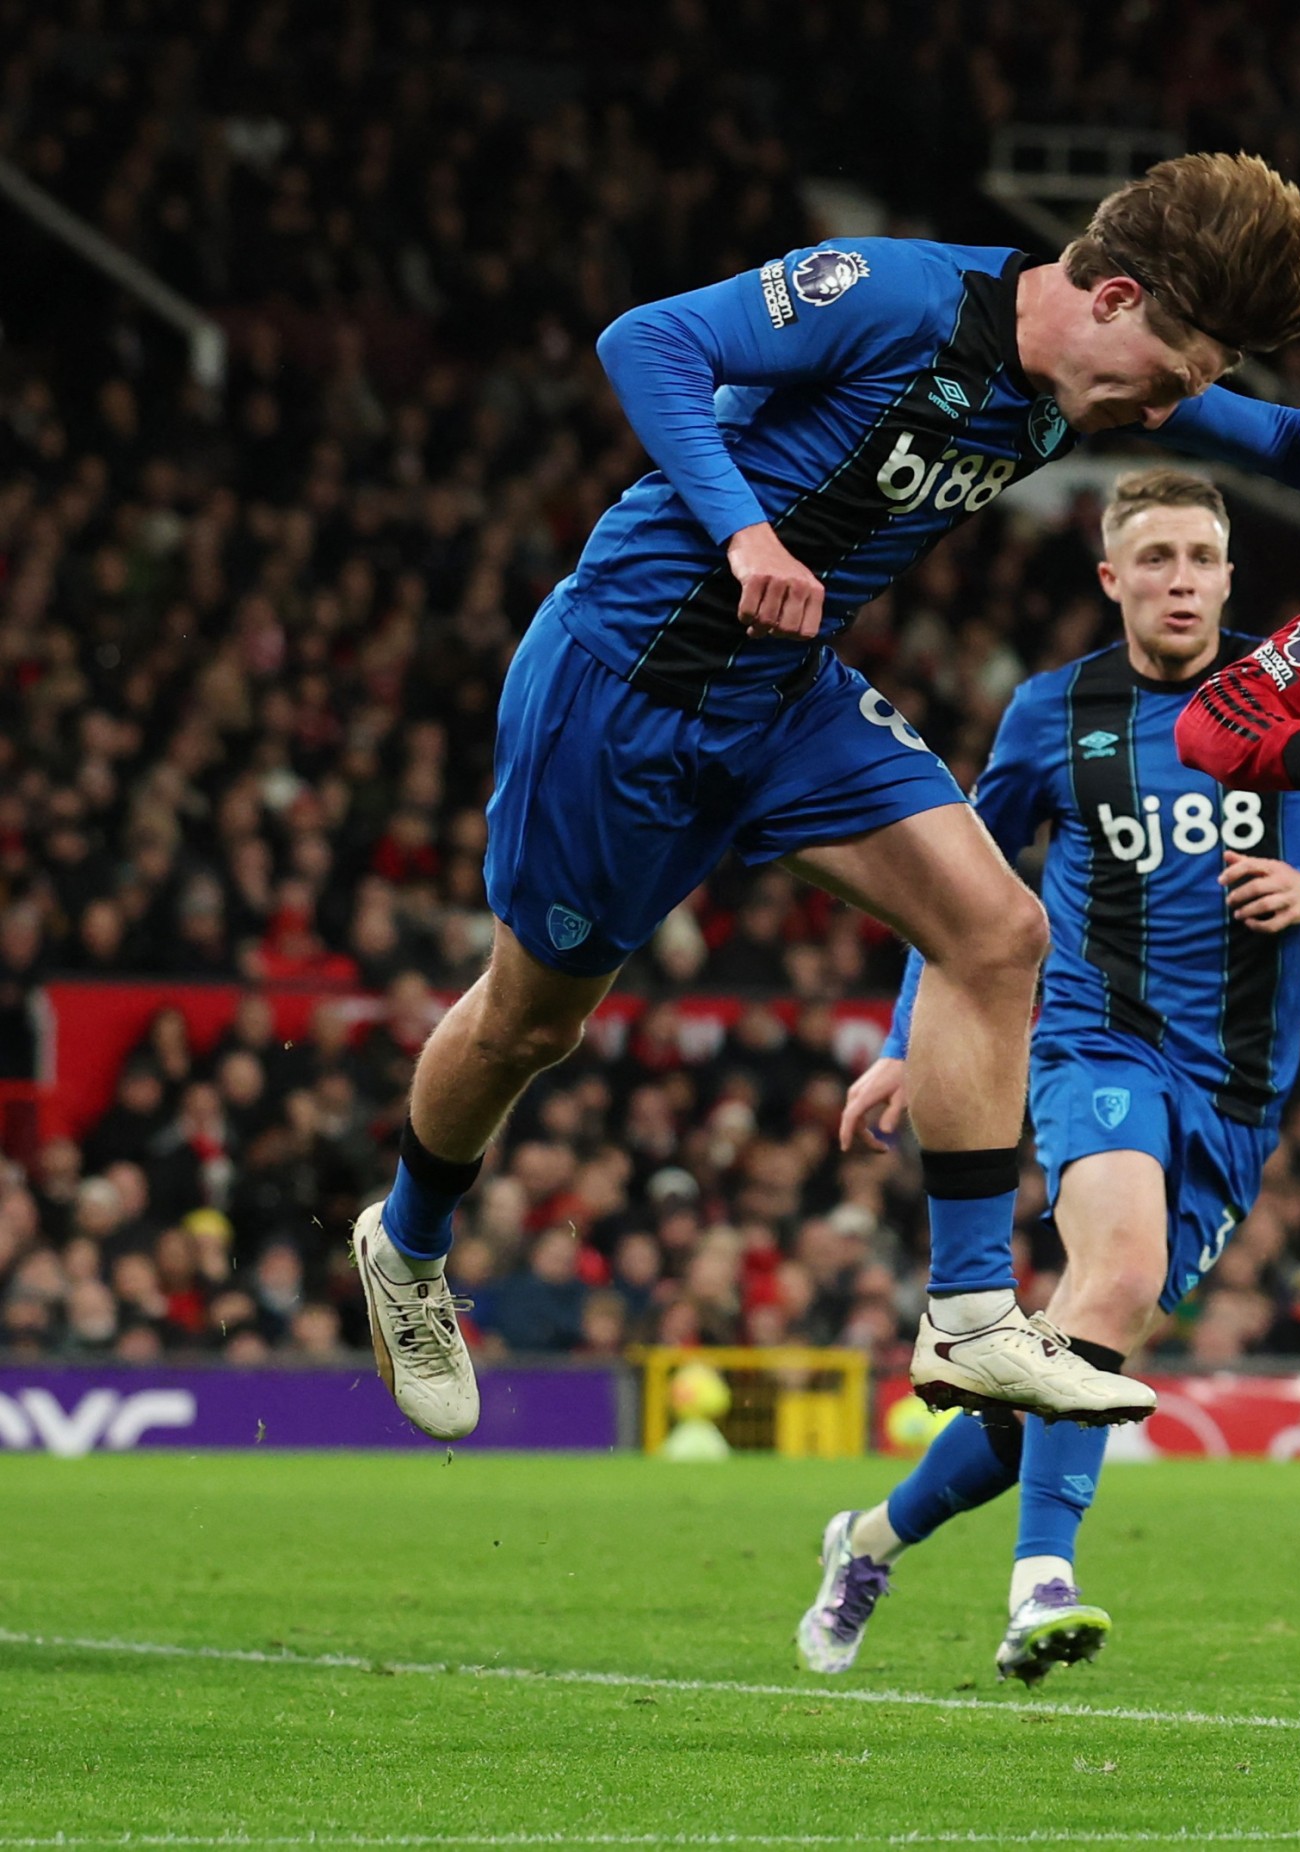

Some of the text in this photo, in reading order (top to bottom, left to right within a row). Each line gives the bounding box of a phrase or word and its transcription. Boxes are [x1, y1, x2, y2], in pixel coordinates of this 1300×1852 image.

[762, 282, 785, 329] racism
[774, 279, 794, 319] room
[928, 391, 959, 419] umbro
[876, 431, 1016, 514] bj88
[859, 687, 931, 752] 8
[1097, 790, 1265, 874] bj88
